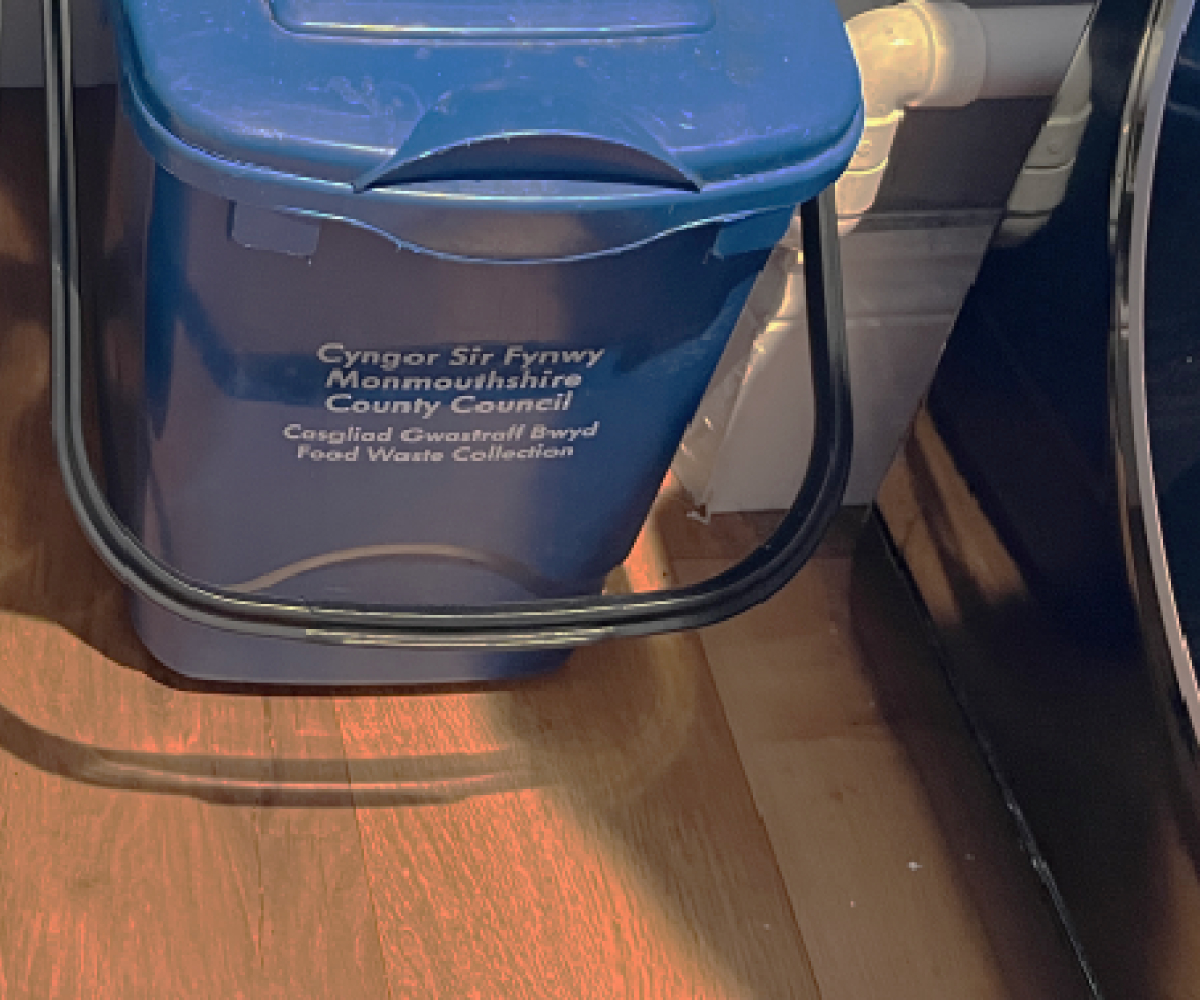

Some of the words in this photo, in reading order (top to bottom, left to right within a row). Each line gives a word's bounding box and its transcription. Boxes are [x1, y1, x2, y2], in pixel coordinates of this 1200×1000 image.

[316, 342, 440, 371] Cyngor
[449, 346, 494, 366] Sir
[504, 344, 605, 371] Fynwy
[325, 368, 582, 391] Monmouthshire
[325, 393, 441, 419] County
[450, 390, 573, 413] Council
[282, 423, 393, 444] Casgliad
[401, 422, 525, 442] Gwastraff
[530, 420, 600, 440] Bwyd
[298, 443, 359, 462] Food
[367, 445, 443, 462] Waste
[453, 443, 574, 462] Collection
